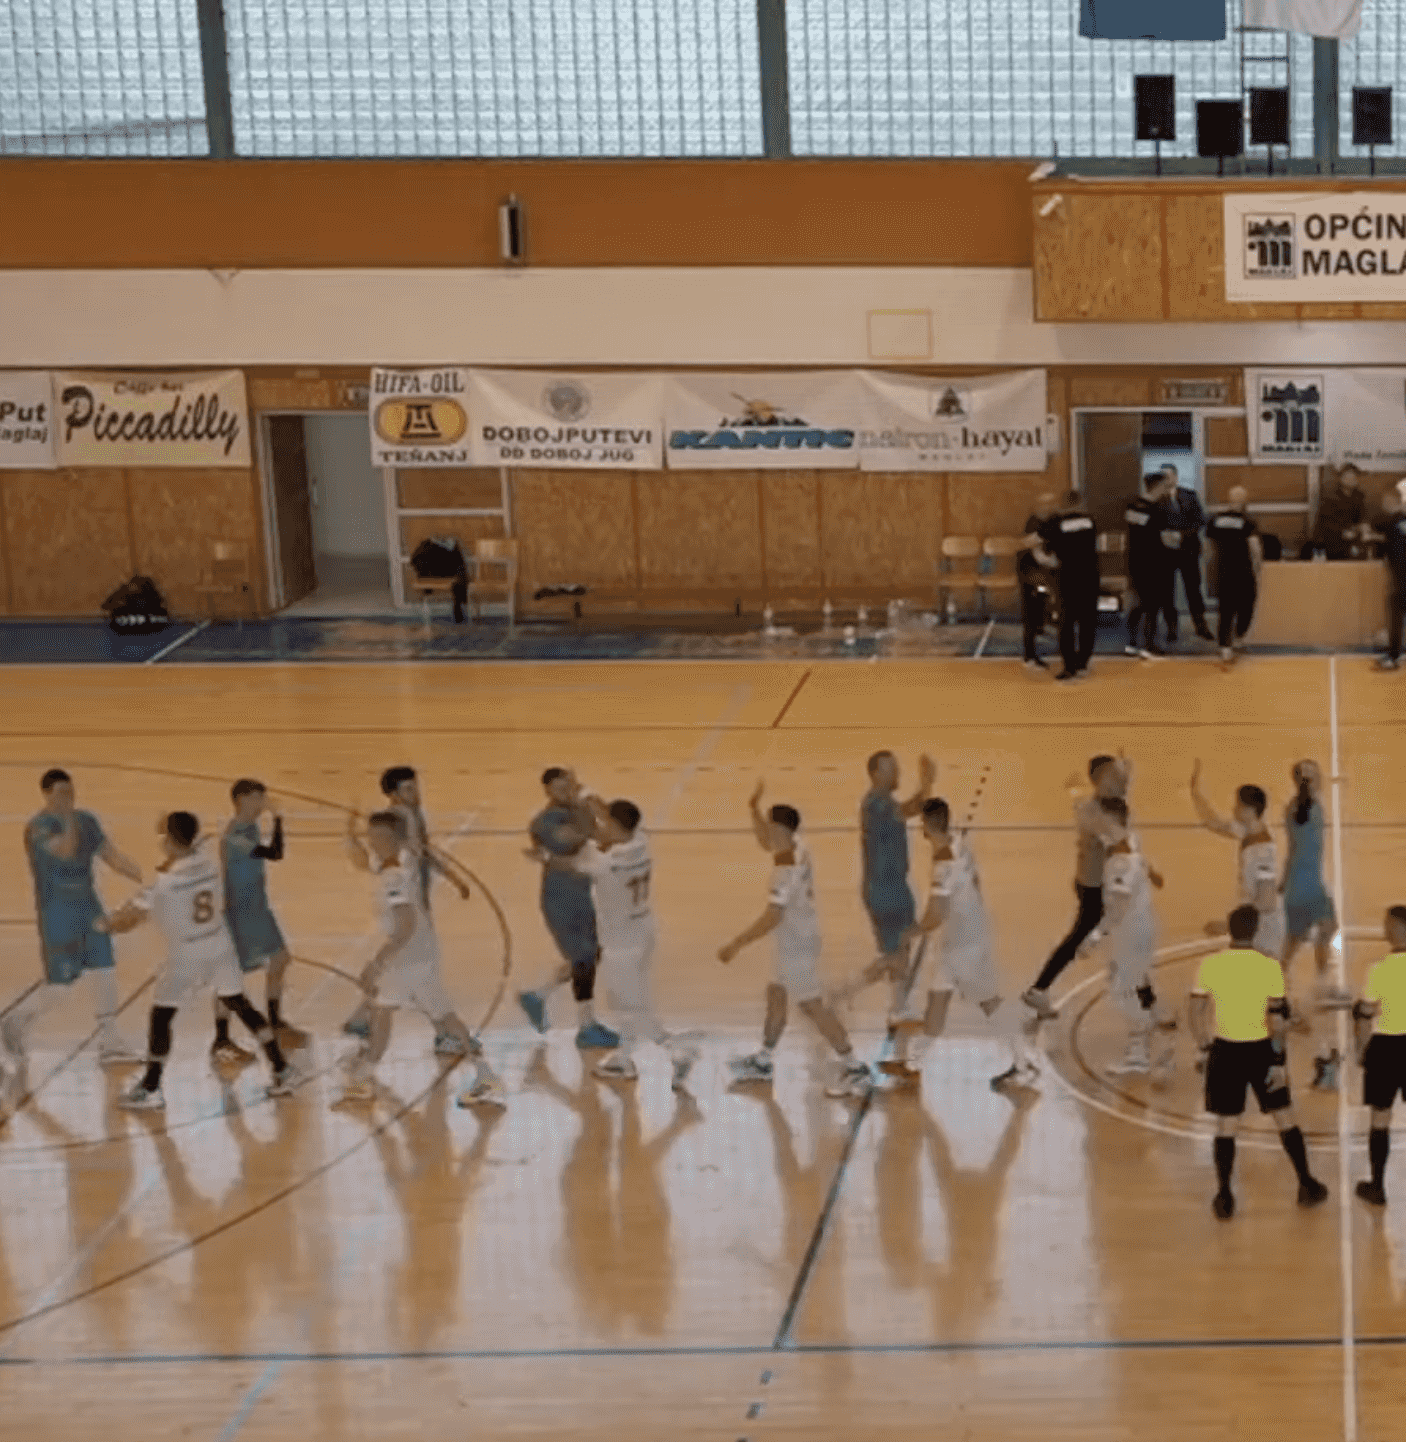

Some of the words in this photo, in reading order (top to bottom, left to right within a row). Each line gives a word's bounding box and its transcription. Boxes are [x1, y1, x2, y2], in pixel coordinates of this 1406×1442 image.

[374, 371, 465, 394] HIFA-OIL
[61, 385, 240, 456] Piccadilly
[0, 427, 48, 444] aglaj
[482, 425, 652, 445] DOBOJPUTEVI
[501, 448, 525, 460] DD
[531, 448, 592, 461] DOBOJ
[599, 449, 635, 462] JUG
[193, 890, 215, 924] 8
